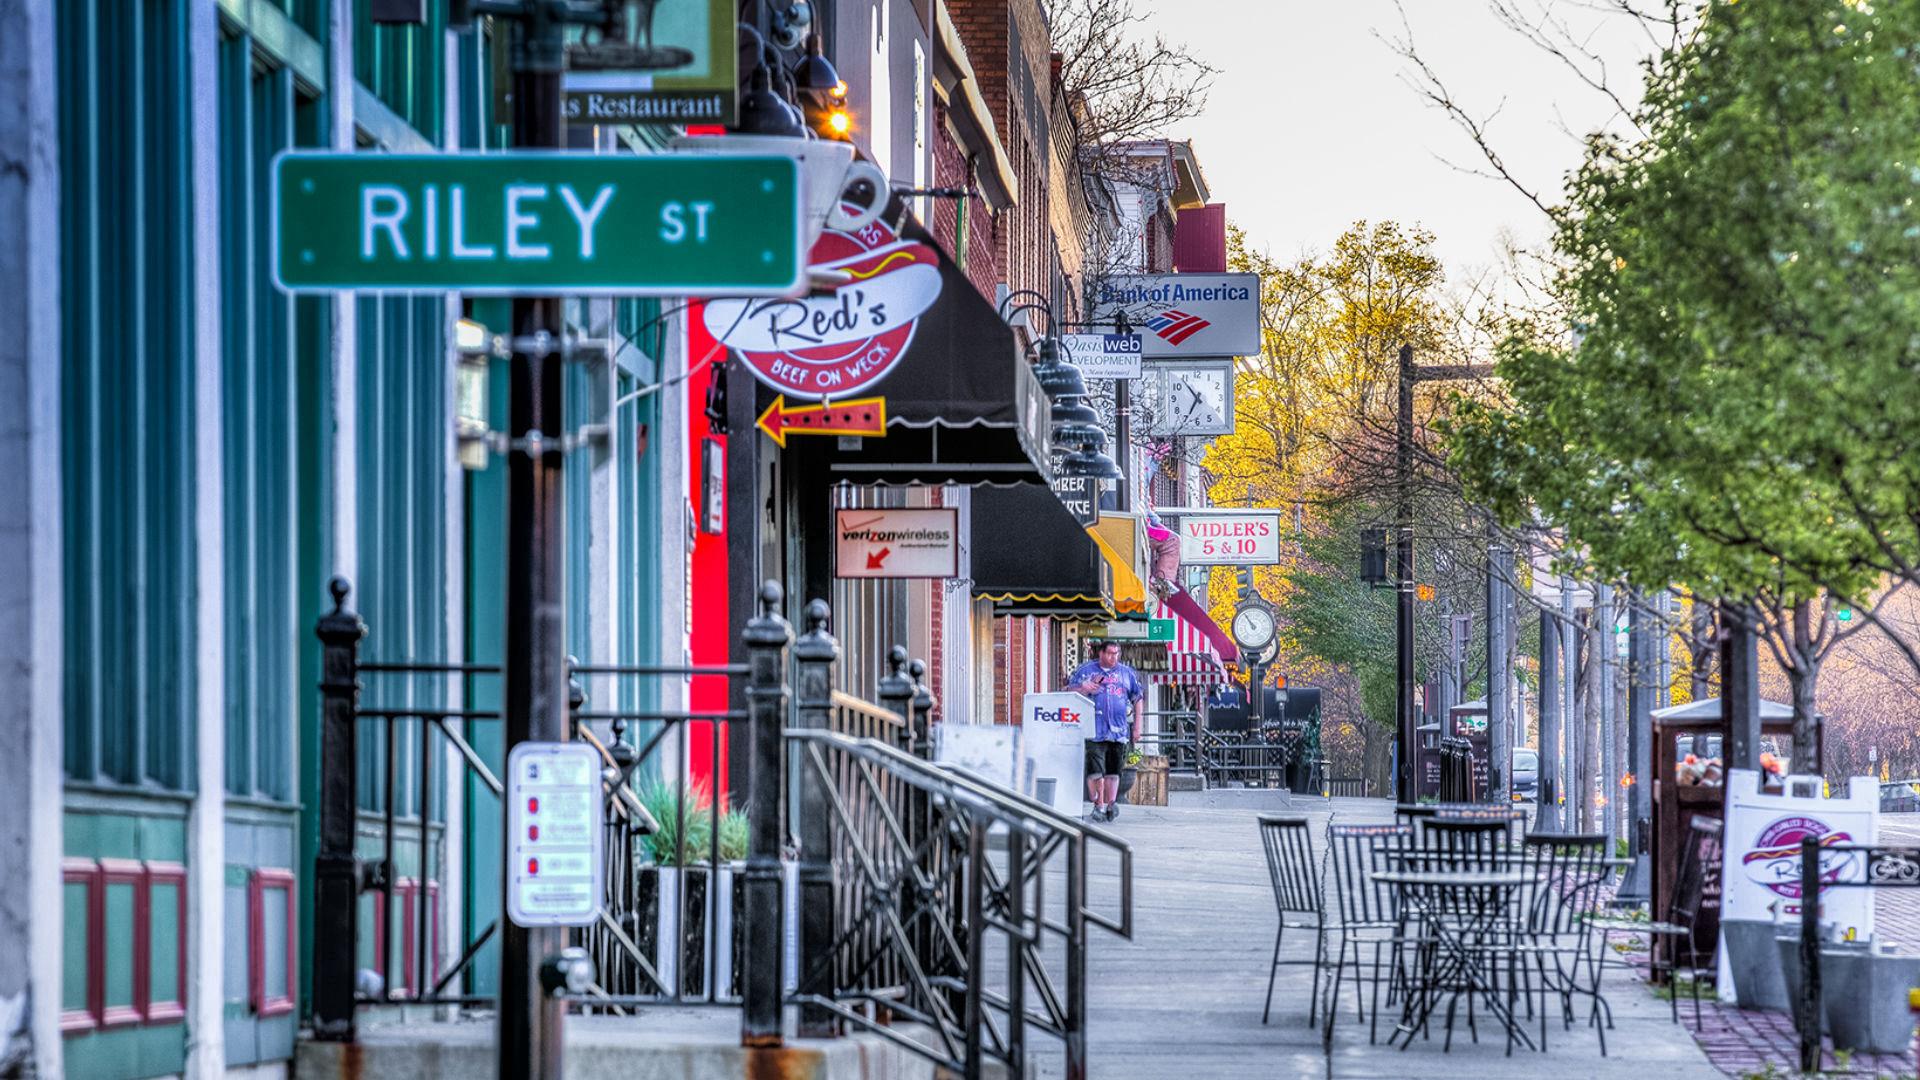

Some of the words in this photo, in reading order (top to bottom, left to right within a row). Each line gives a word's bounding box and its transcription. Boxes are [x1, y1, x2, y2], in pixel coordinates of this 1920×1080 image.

[588, 93, 722, 118] Restaurant
[360, 184, 615, 259] RILEY
[659, 201, 714, 243] ST
[1102, 284, 1150, 303] Bank
[1151, 284, 1170, 302] of
[1173, 283, 1249, 301] America
[749, 290, 886, 346] Red's
[1105, 336, 1140, 351] web
[771, 359, 809, 384] BEEF
[816, 368, 842, 387] ON
[845, 343, 890, 378] WECK
[1173, 383, 1182, 391] 10
[1050, 477, 1085, 492] MBER
[1189, 522, 1269, 537] VIDLER'S
[1203, 539, 1215, 555] 5
[1221, 541, 1231, 554] &
[1237, 539, 1256, 555] 10
[1153, 626, 1162, 634] ST
[1034, 707, 1081, 722] FedEx
